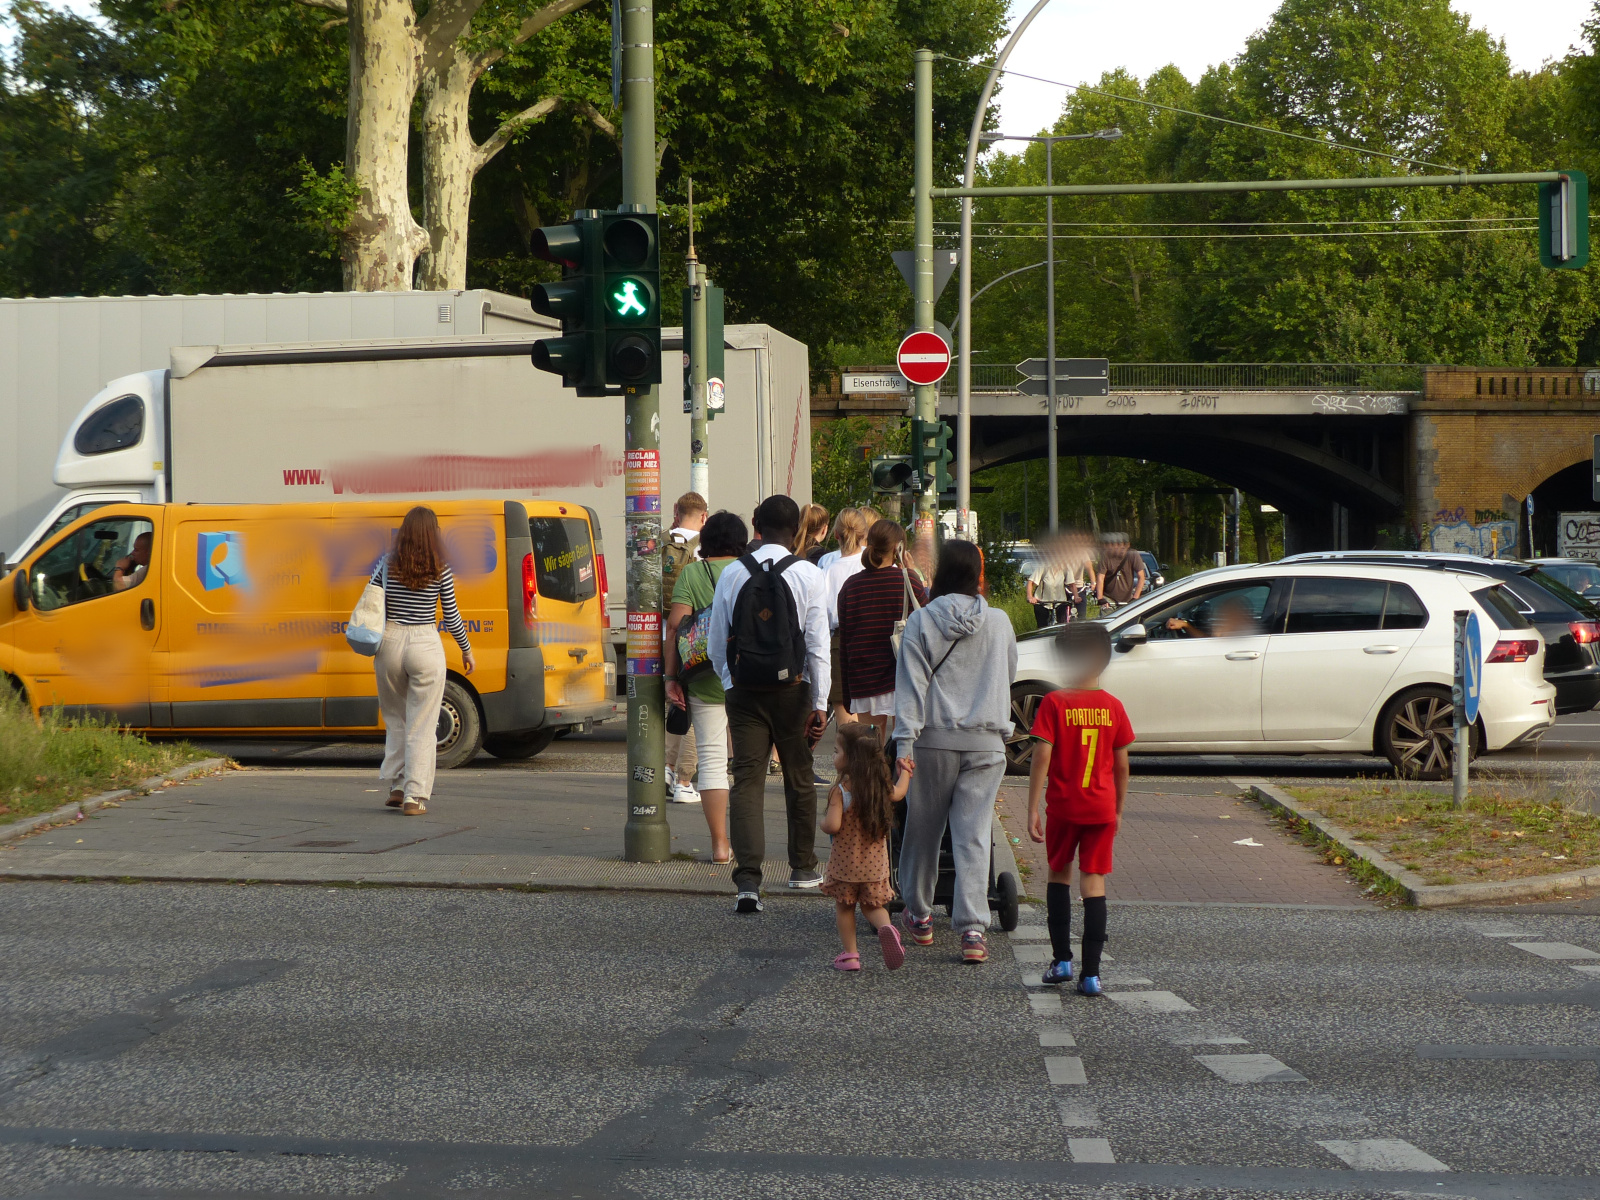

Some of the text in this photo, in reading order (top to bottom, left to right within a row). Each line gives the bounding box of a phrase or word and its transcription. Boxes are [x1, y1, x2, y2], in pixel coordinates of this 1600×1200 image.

[853, 377, 900, 389] Elsenstraße
[627, 452, 656, 460] RECLAIM
[543, 555, 557, 573] Wir
[557, 550, 577, 569] sägen
[644, 623, 659, 631] KIEZ
[1065, 708, 1112, 727] PORTUGAL
[1081, 728, 1099, 788] 7
